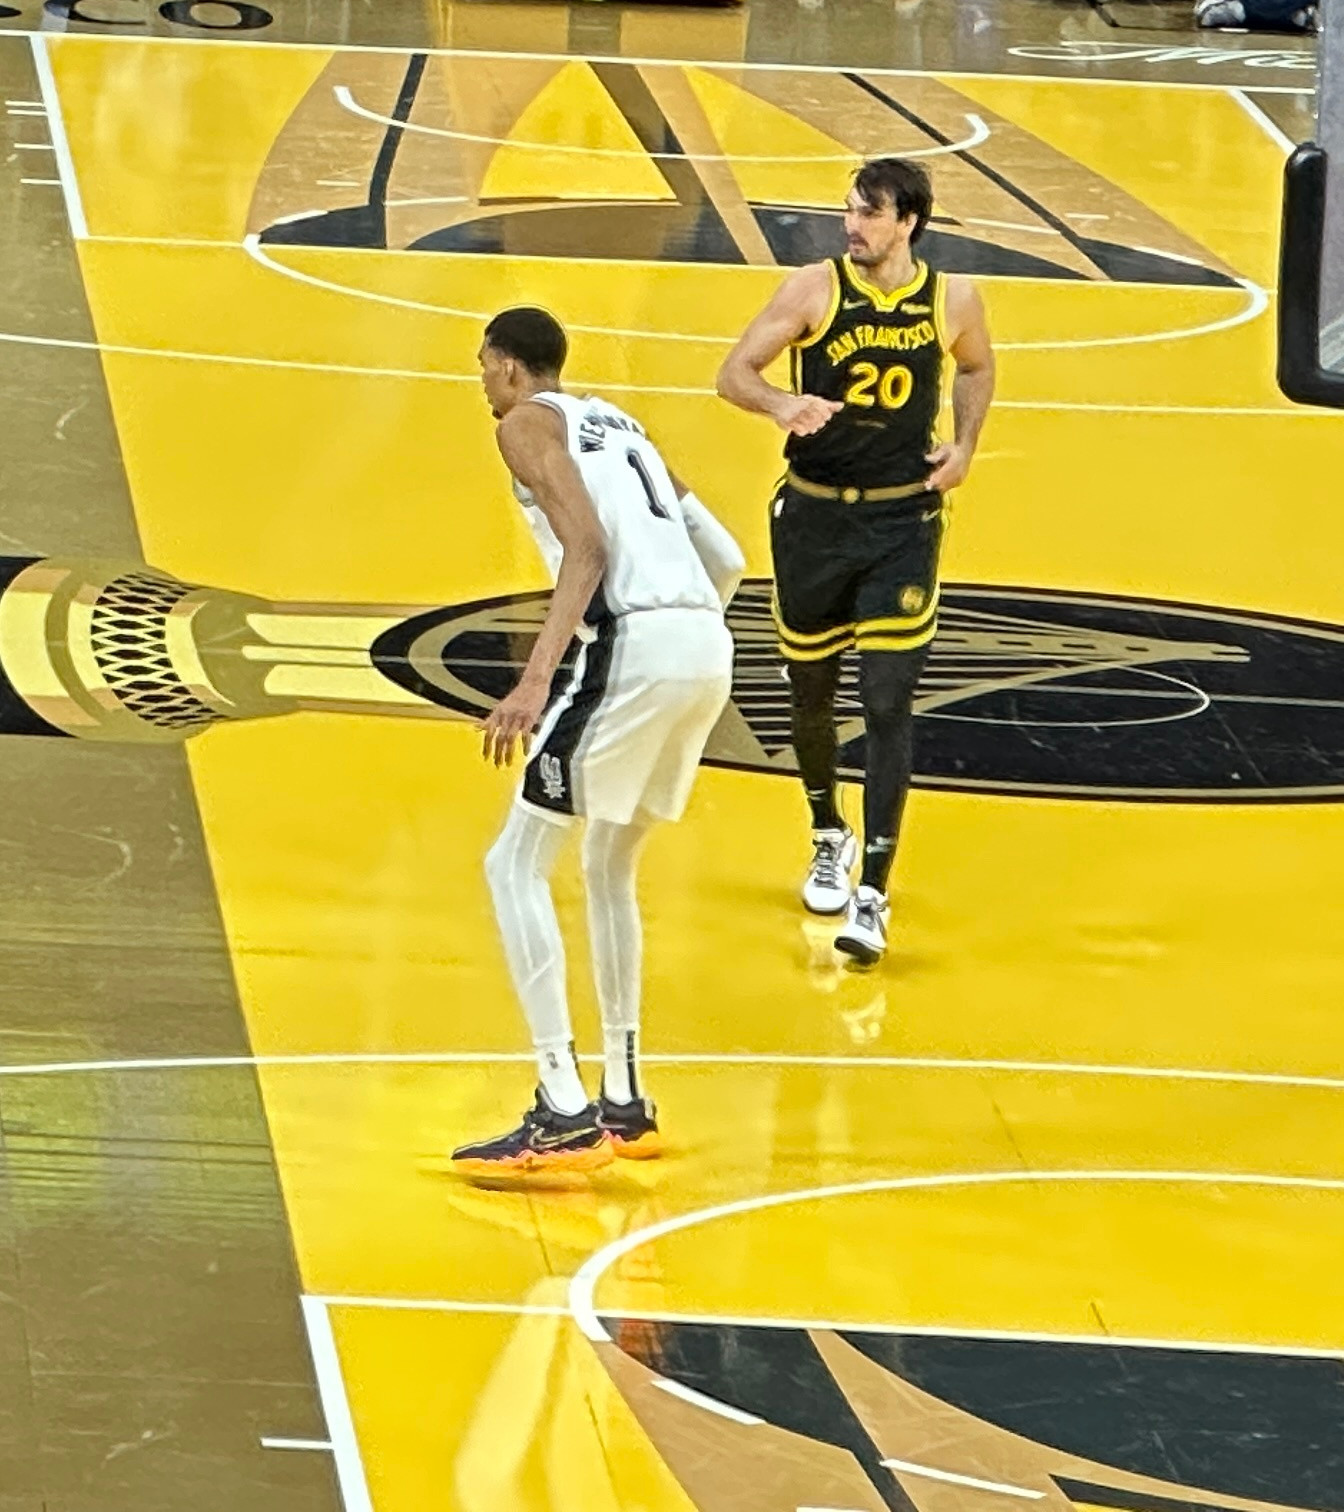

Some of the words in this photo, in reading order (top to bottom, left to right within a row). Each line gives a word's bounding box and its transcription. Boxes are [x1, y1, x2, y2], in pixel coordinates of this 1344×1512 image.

[826, 332, 858, 366] SAN
[855, 320, 935, 350] FRANCISCO
[845, 361, 914, 409] 20
[626, 448, 673, 520] 1
